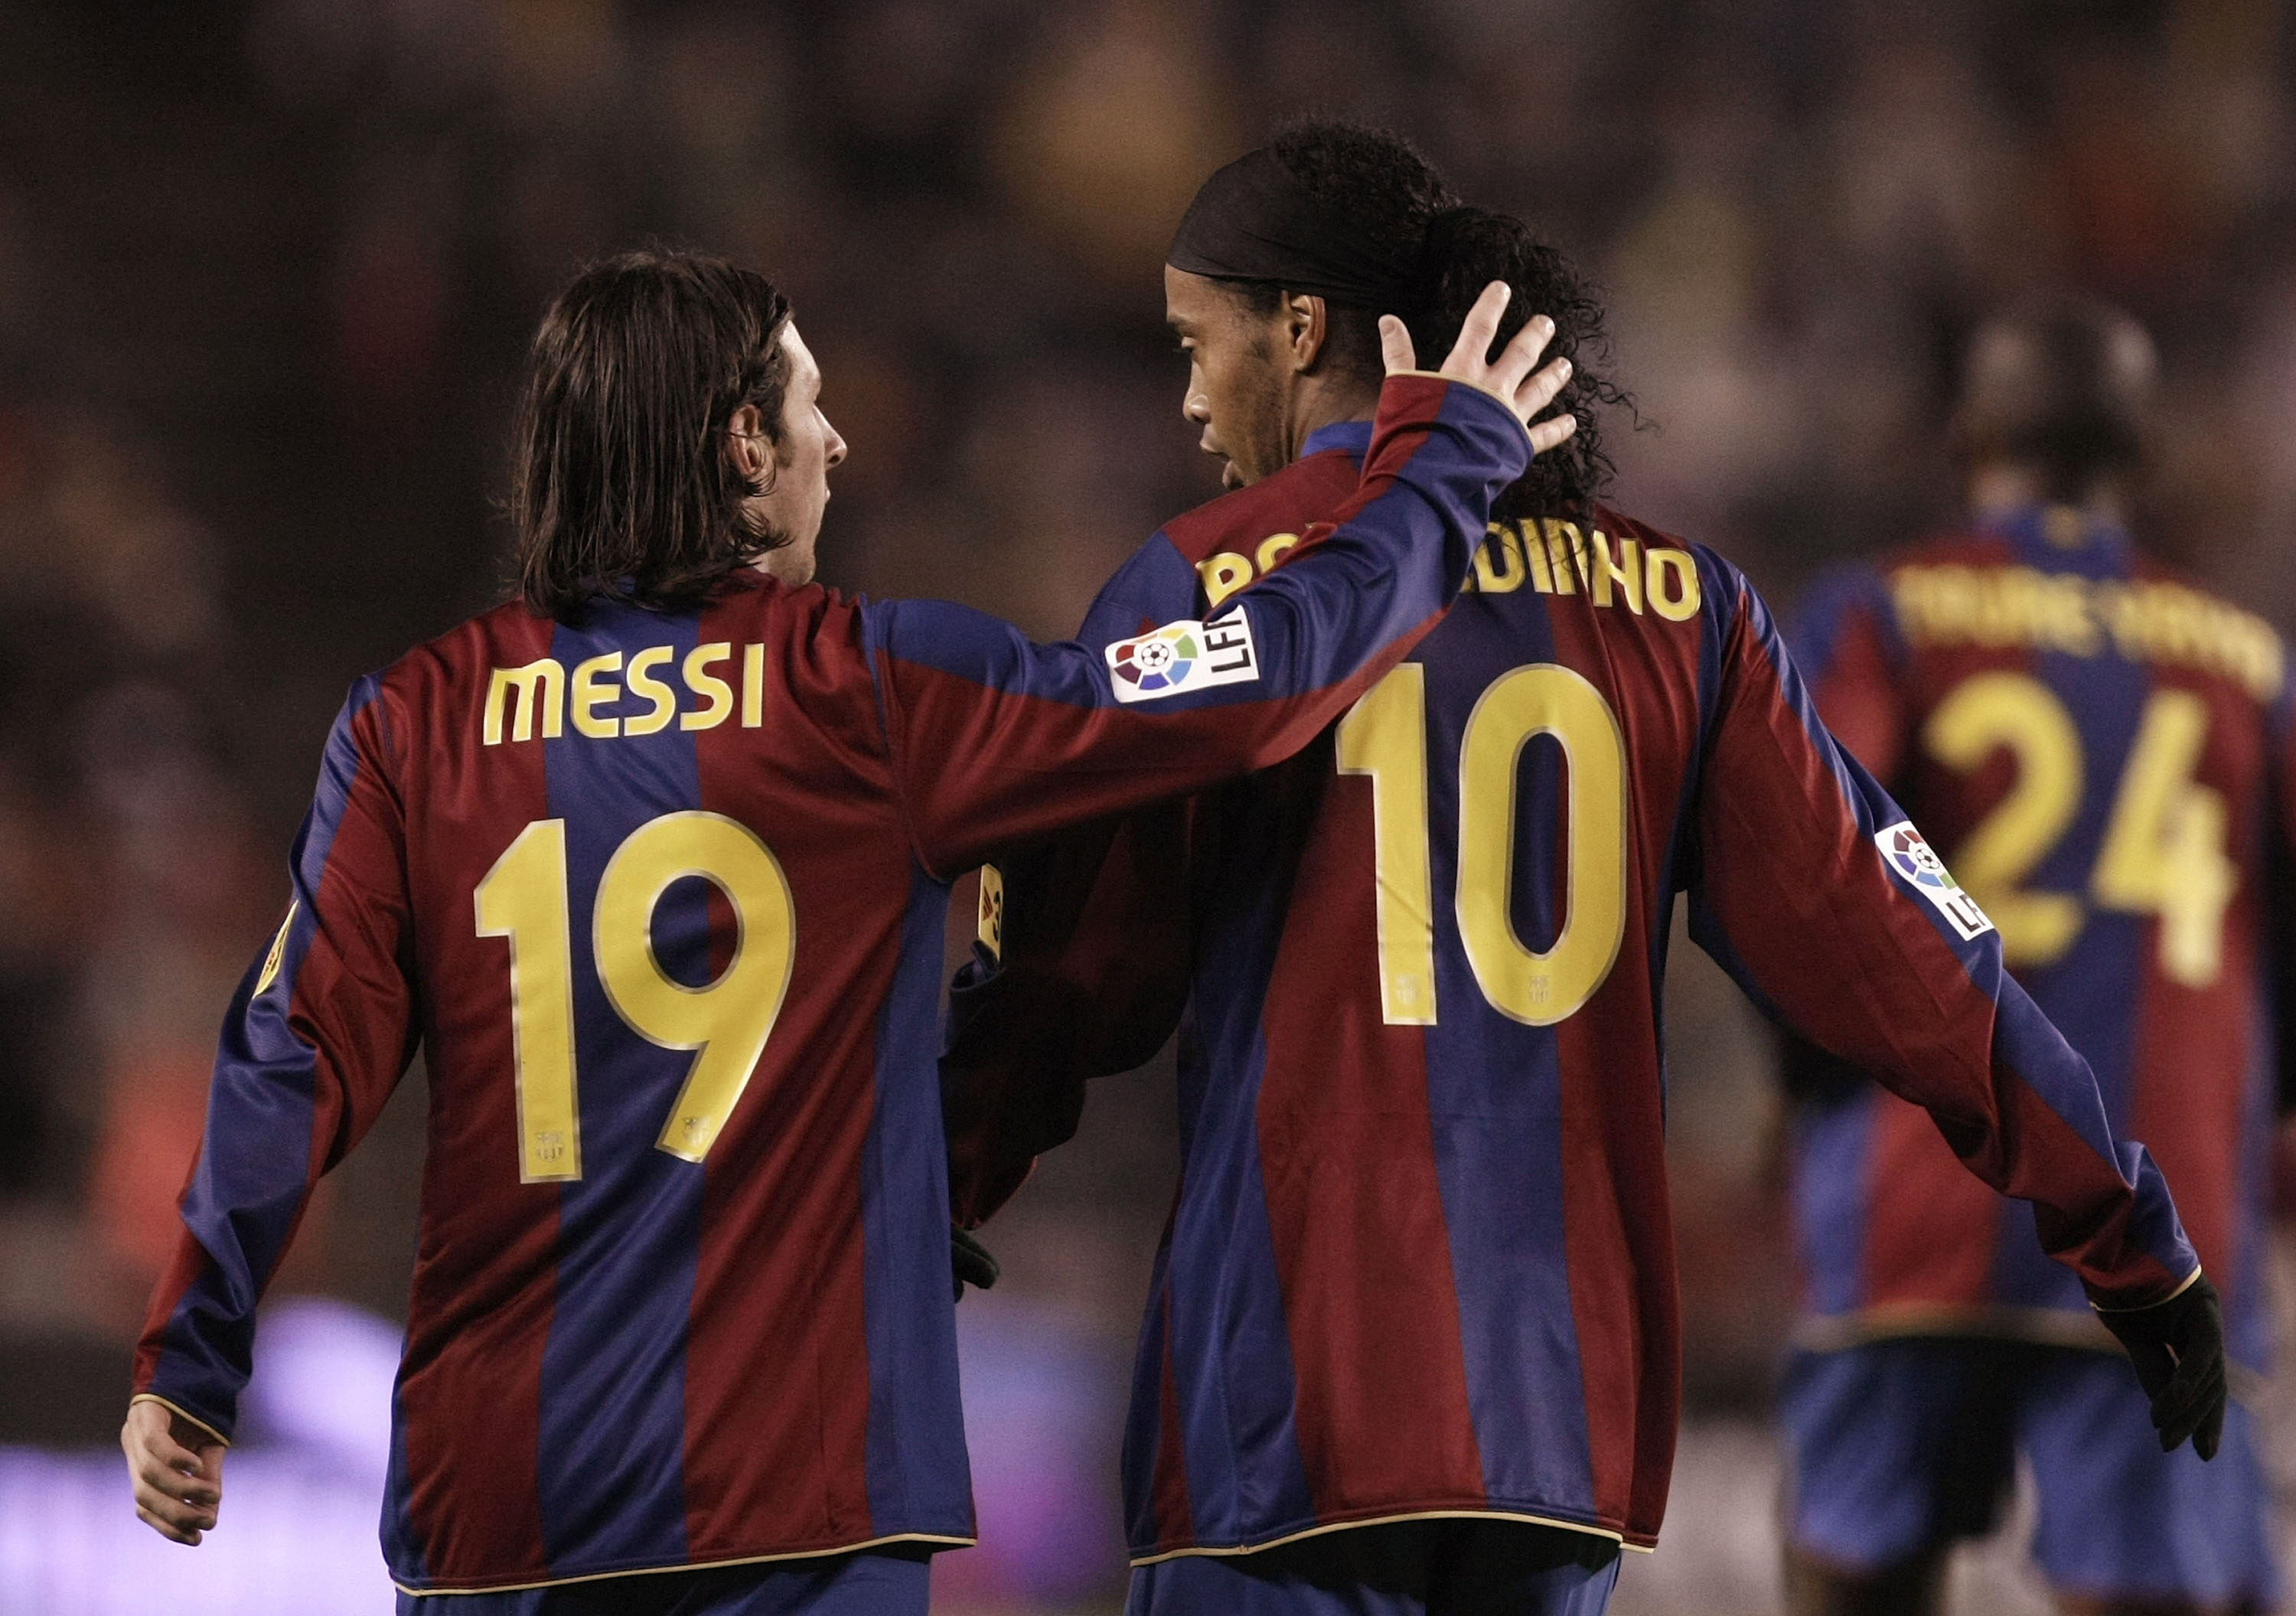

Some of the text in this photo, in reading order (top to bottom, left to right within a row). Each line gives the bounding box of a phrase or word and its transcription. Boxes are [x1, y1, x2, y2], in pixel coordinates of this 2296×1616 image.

[484, 642, 765, 745] MESSI
[1335, 661, 1627, 1027] 10
[1924, 671, 2238, 988] 24
[473, 810, 797, 1184] 19
